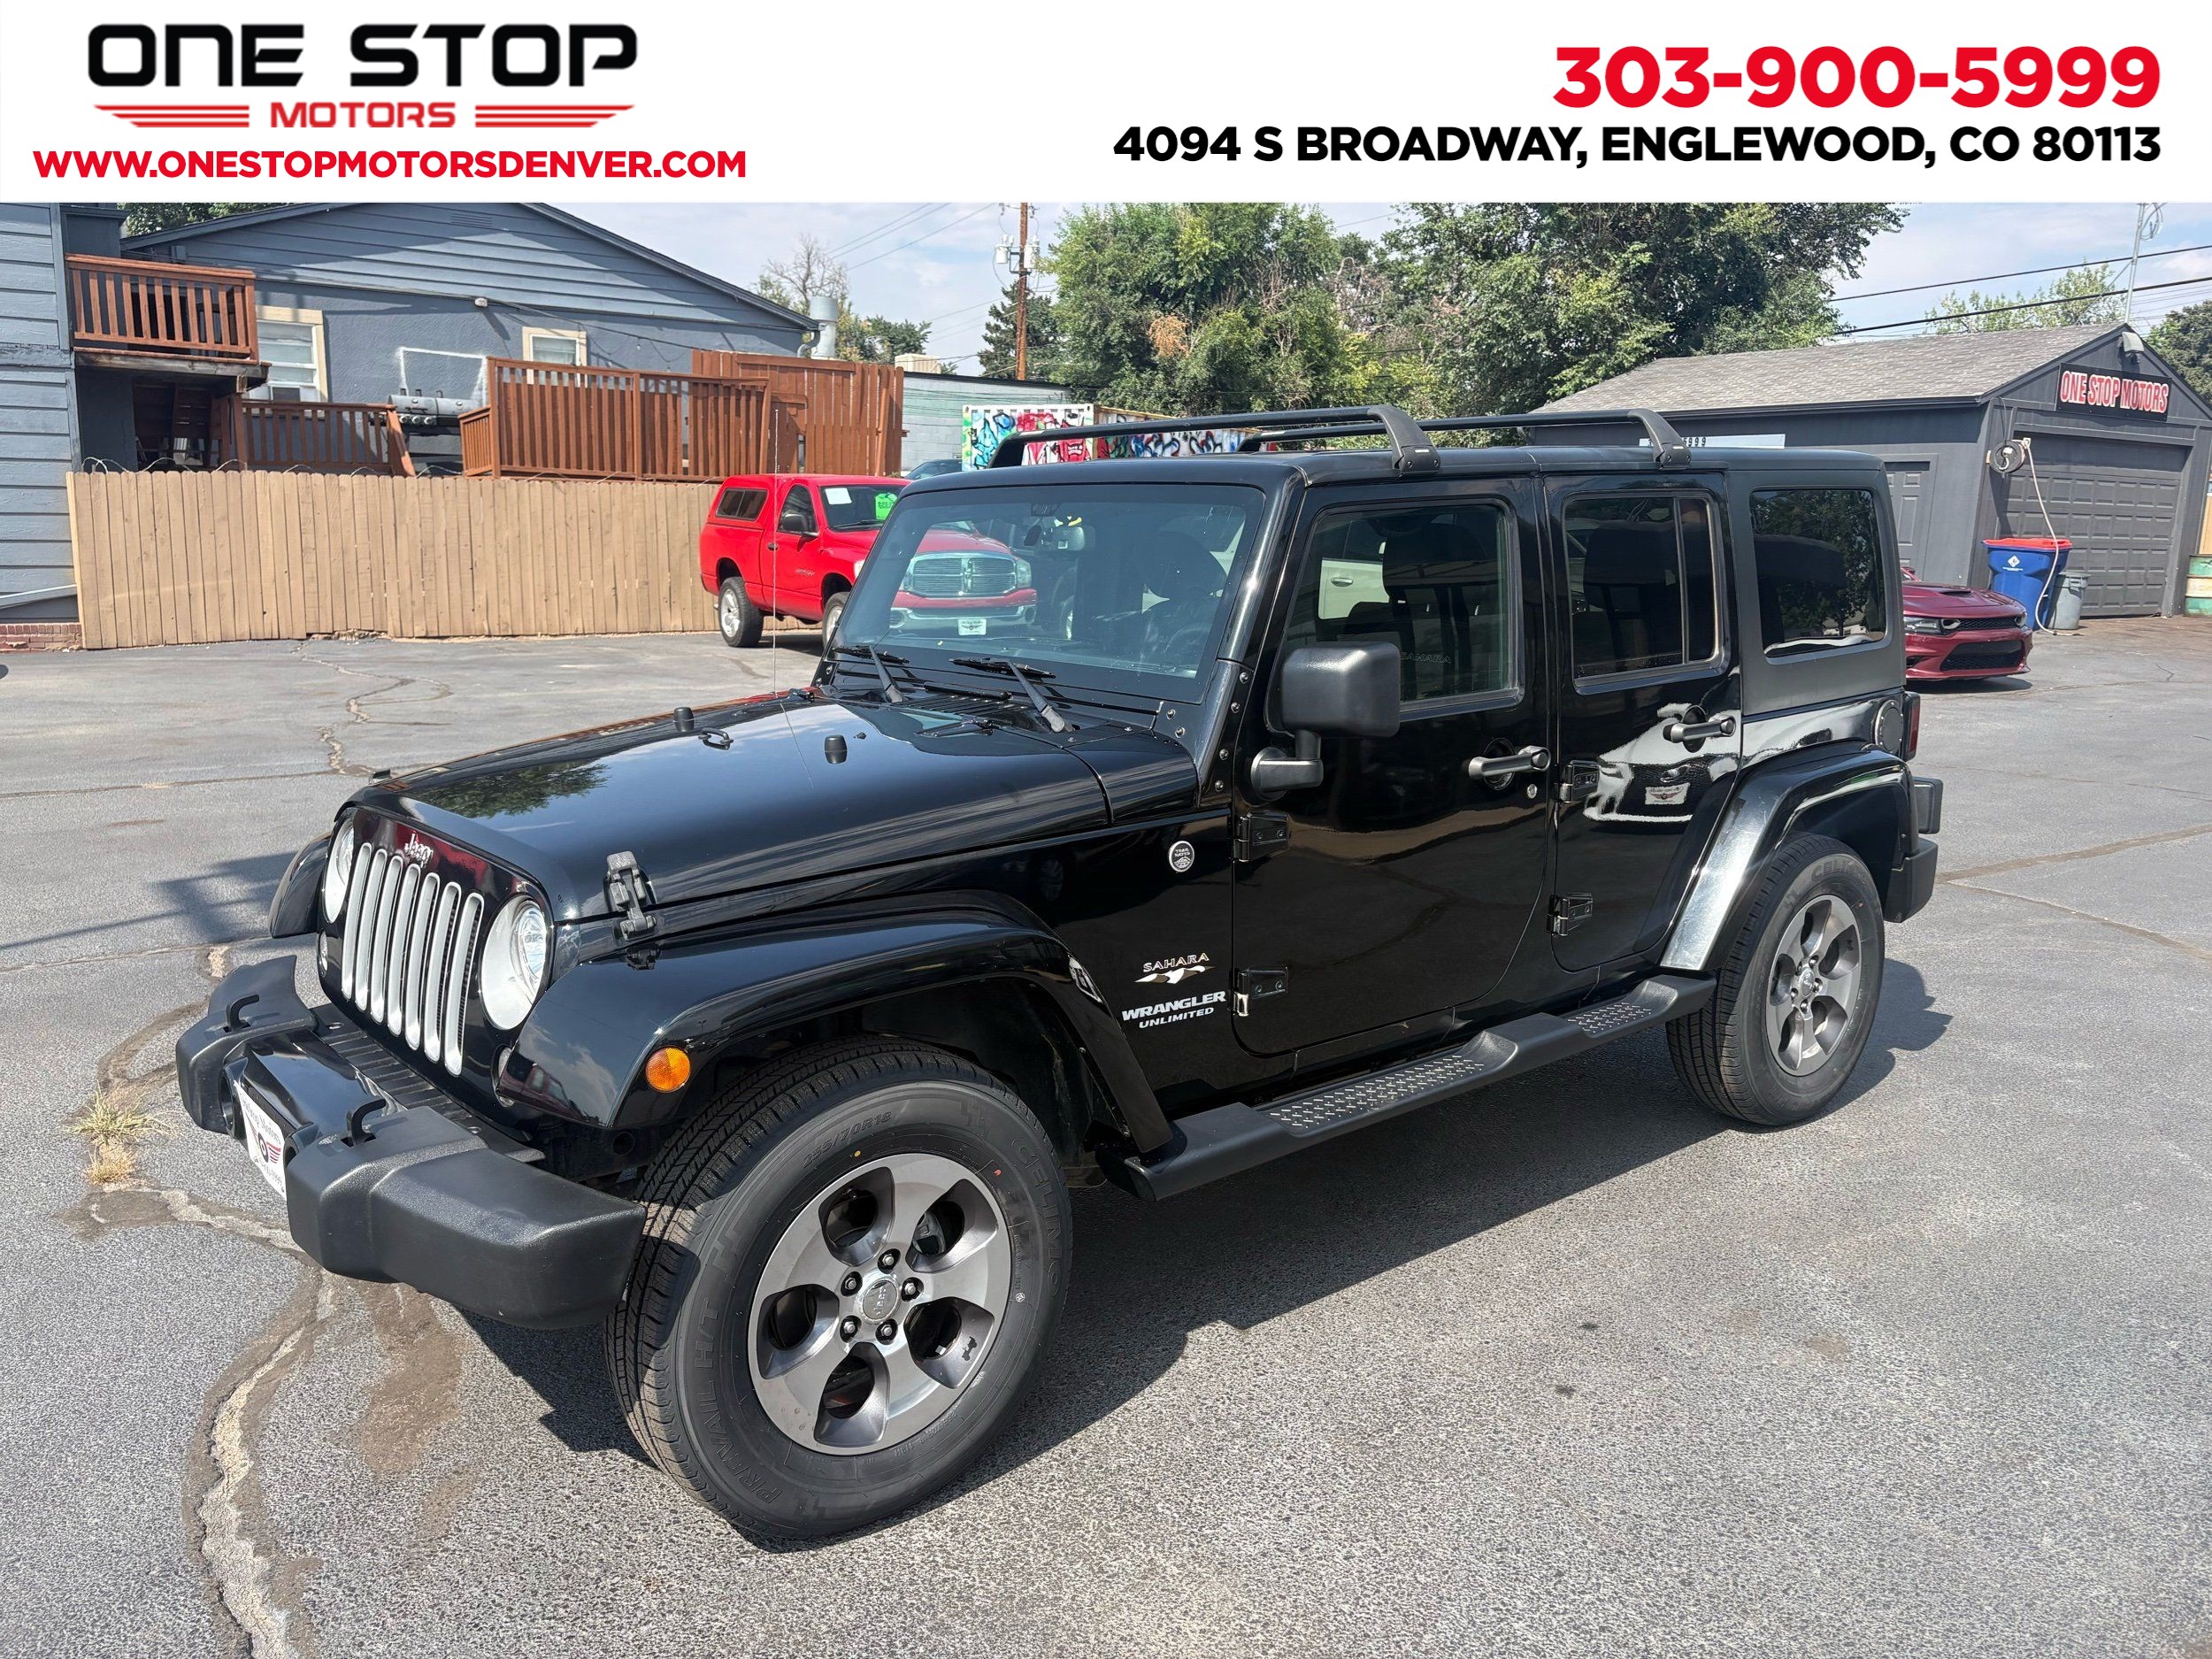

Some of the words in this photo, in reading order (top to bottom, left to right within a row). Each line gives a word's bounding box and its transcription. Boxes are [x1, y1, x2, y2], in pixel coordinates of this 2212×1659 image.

[2060, 371, 2087, 404] ONE
[2087, 374, 2121, 407] STOP
[2120, 379, 2169, 413] MOTORS
[1143, 953, 1210, 972] SAHARA
[1122, 991, 1226, 1021] WRANGLER
[1139, 1007, 1214, 1029] UNLIMITED
[695, 1297, 719, 1369] H/T
